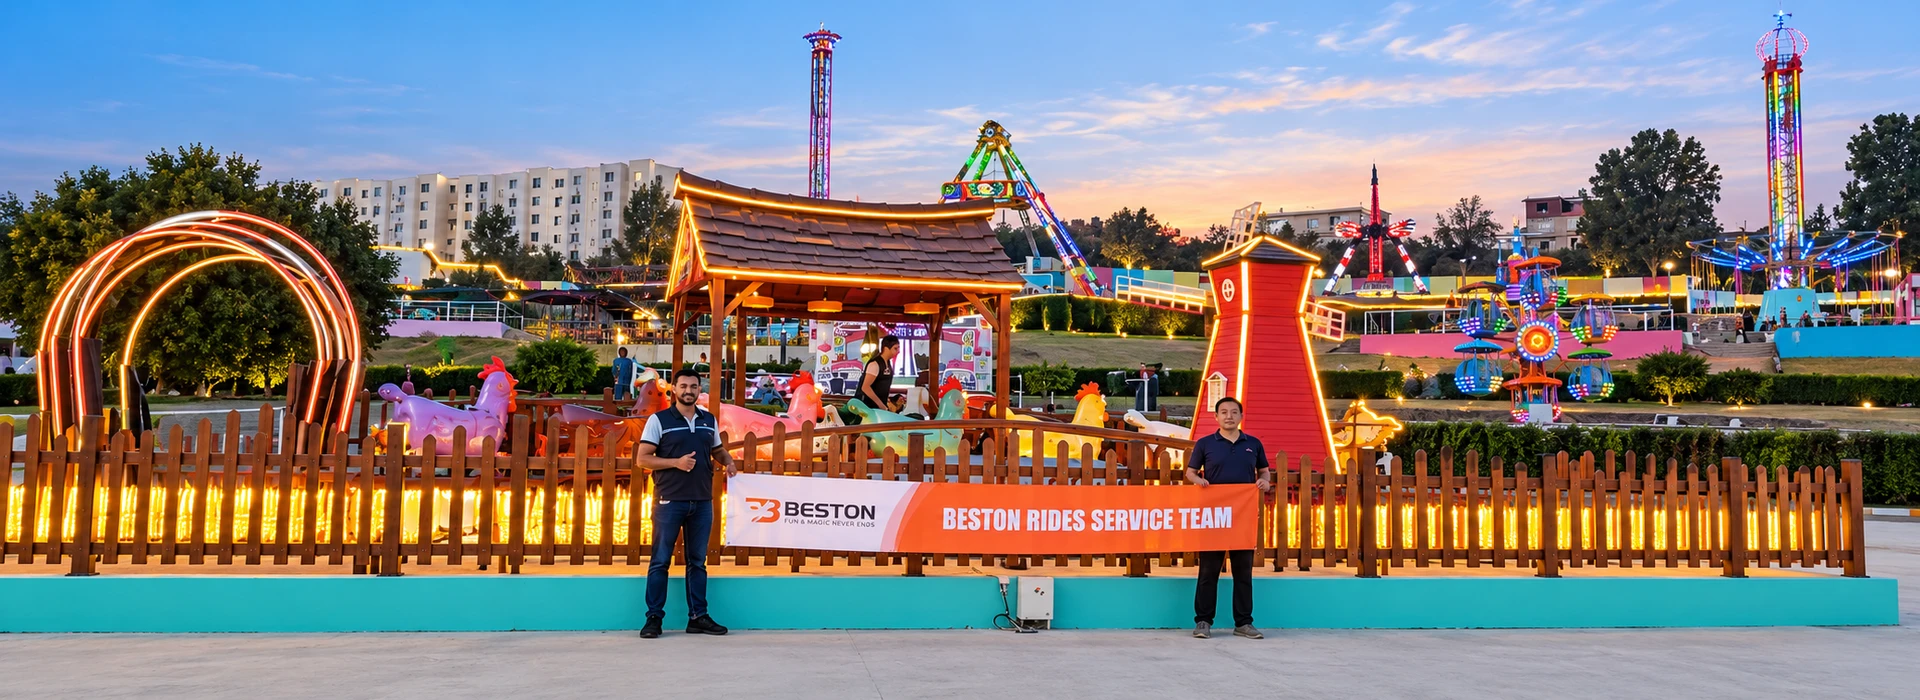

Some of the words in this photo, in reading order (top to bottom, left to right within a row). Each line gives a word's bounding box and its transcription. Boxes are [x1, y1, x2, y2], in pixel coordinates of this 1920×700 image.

[784, 501, 876, 520] BESTON
[942, 507, 1021, 531] BESTON
[1026, 509, 1086, 532] RIDES
[1090, 508, 1174, 532] SERVICE
[1178, 506, 1232, 530] TEAM
